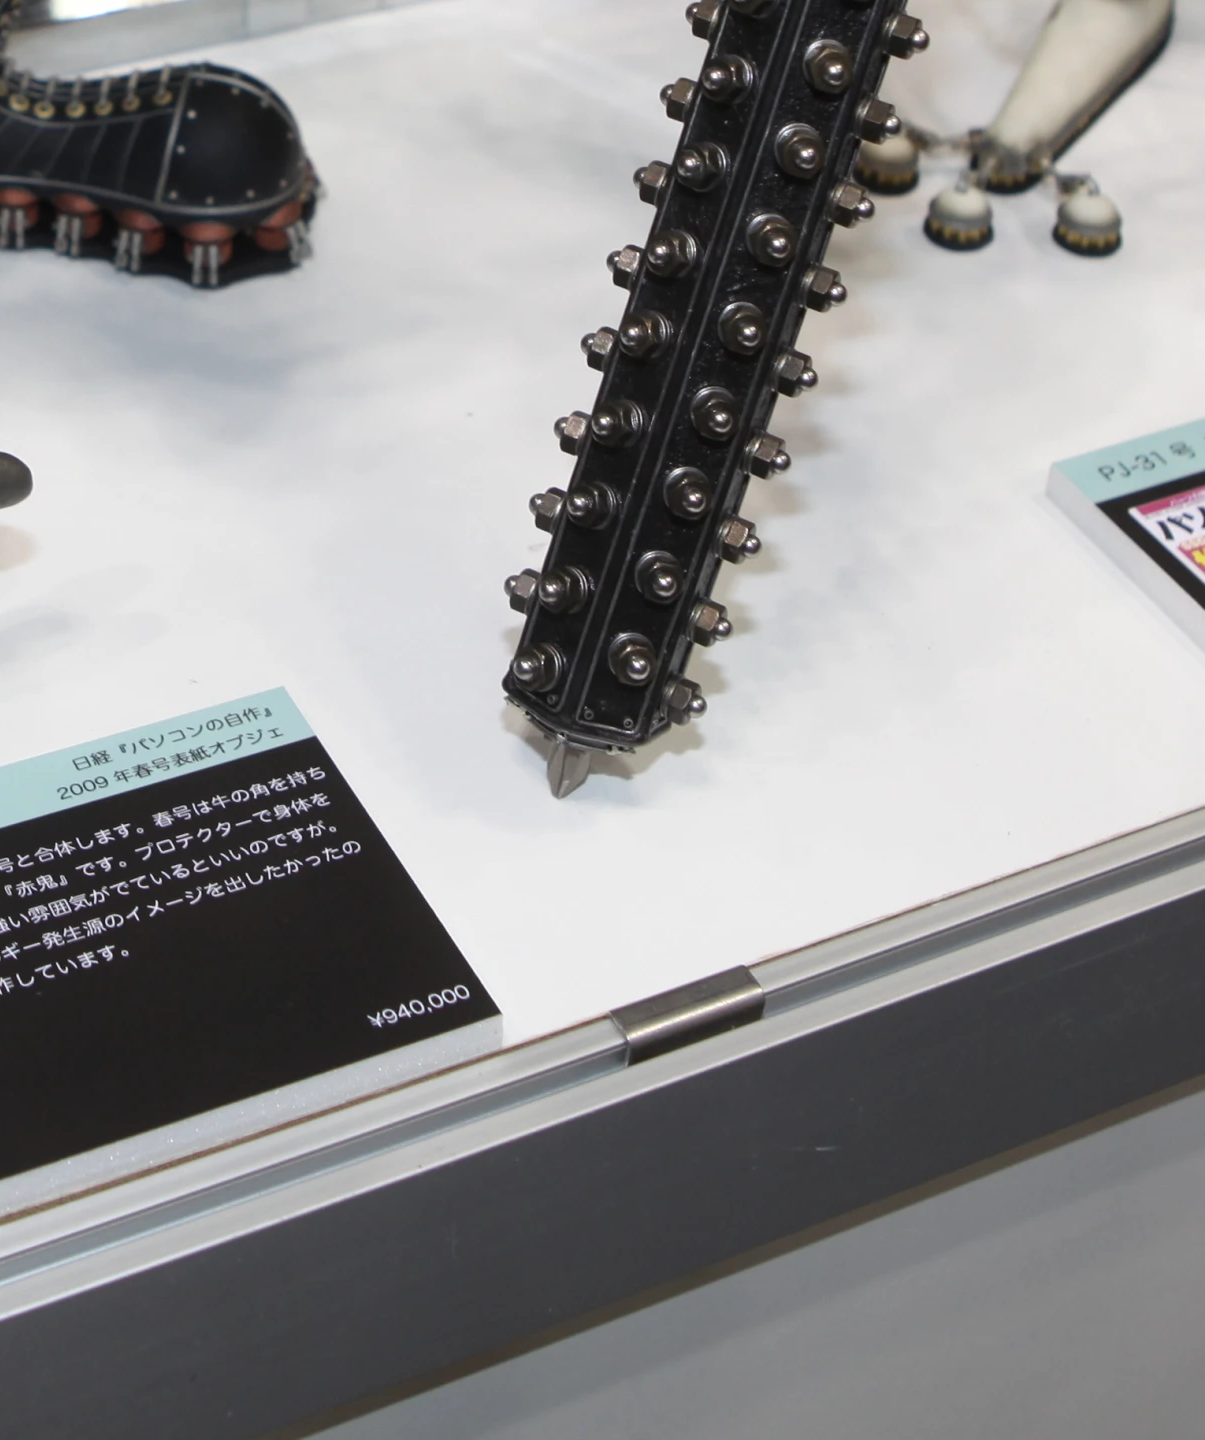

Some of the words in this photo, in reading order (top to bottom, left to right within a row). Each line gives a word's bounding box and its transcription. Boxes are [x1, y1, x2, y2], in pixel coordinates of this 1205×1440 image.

[1156, 505, 1205, 541] パ
[57, 729, 279, 799] 2009年春号表紙オブジェ
[72, 708, 271, 770] 日経『パソコンの自作』
[367, 984, 469, 1026] ¥940,000
